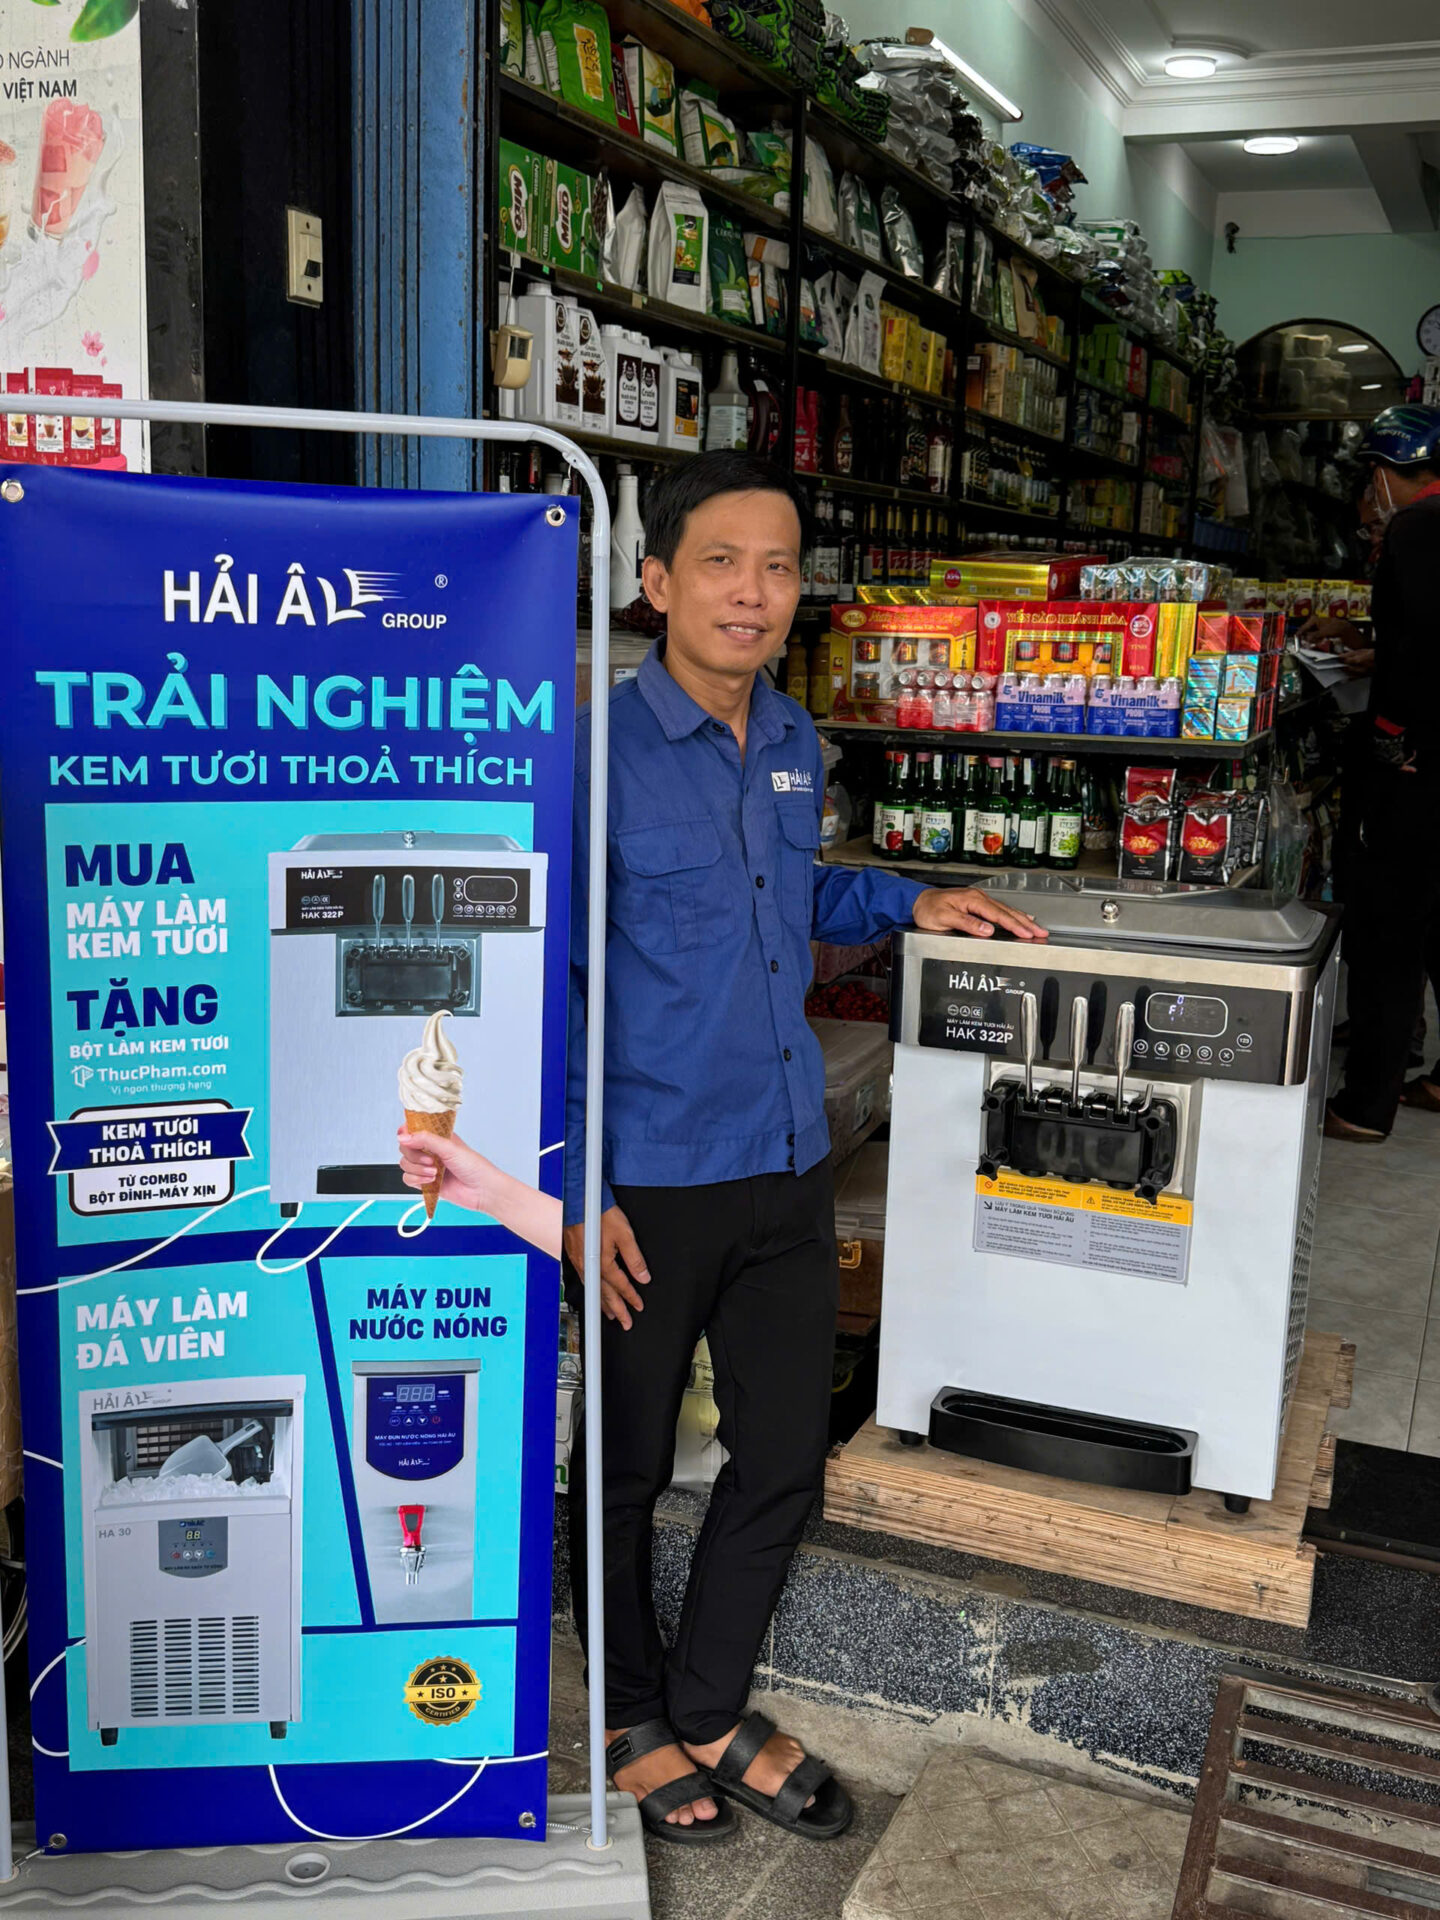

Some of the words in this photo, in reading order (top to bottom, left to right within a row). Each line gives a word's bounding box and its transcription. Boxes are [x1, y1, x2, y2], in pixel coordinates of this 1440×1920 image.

[9, 46, 69, 69] NGÀNH
[3, 78, 34, 103] VIỆT
[39, 80, 76, 98] NAM
[164, 554, 258, 625] HẢI
[382, 613, 447, 629] GROUP
[35, 652, 228, 729] TRẢI
[257, 664, 556, 745] NGHIỆM
[1018, 690, 1066, 704] Vinamilk
[1110, 694, 1160, 708] Vinamilk
[50, 755, 148, 786] KEM
[162, 750, 268, 785] TƯƠI
[281, 745, 400, 784] THOẢ
[410, 749, 533, 786] THÍCH
[64, 843, 195, 887] MUA
[66, 896, 144, 929] MÁY
[156, 894, 226, 926] LÀM
[68, 931, 141, 960] KEM
[152, 925, 228, 955] TƯƠI
[949, 971, 973, 990] HẢI
[66, 978, 218, 1037] TẶNG
[946, 1026, 976, 1040] HAK
[979, 1029, 1014, 1043] 322P
[70, 1044, 103, 1060] BỘT
[108, 1040, 144, 1056] LÀM
[150, 1039, 185, 1053] KEM
[191, 1035, 228, 1051] TƯƠI
[97, 1063, 227, 1082] ThucPham.com
[124, 1086, 148, 1096] ngon
[102, 1124, 146, 1141] KEM
[153, 1118, 198, 1136] TƯƠI
[89, 1141, 145, 1164] THOẢ
[151, 1139, 211, 1159] THÍCH
[118, 1174, 136, 1187] TỪ
[142, 1172, 187, 1185] COMBO
[89, 1191, 115, 1205] BỘT
[193, 1185, 216, 1198] XỊN
[367, 1284, 427, 1309] MÁY
[435, 1287, 491, 1309] ĐUN
[76, 1295, 160, 1332] MÁY
[172, 1287, 248, 1323] LÀM
[350, 1313, 424, 1340] NƯỚC
[433, 1313, 507, 1339] NÓNG
[76, 1333, 129, 1370] ĐÁ
[140, 1326, 225, 1362] VIÊN
[93, 1392, 119, 1411] HẢI
[98, 1528, 115, 1538] HA
[119, 1527, 131, 1537] 30
[431, 1688, 455, 1699] ISO
[425, 1706, 461, 1717] CERTIFIED
